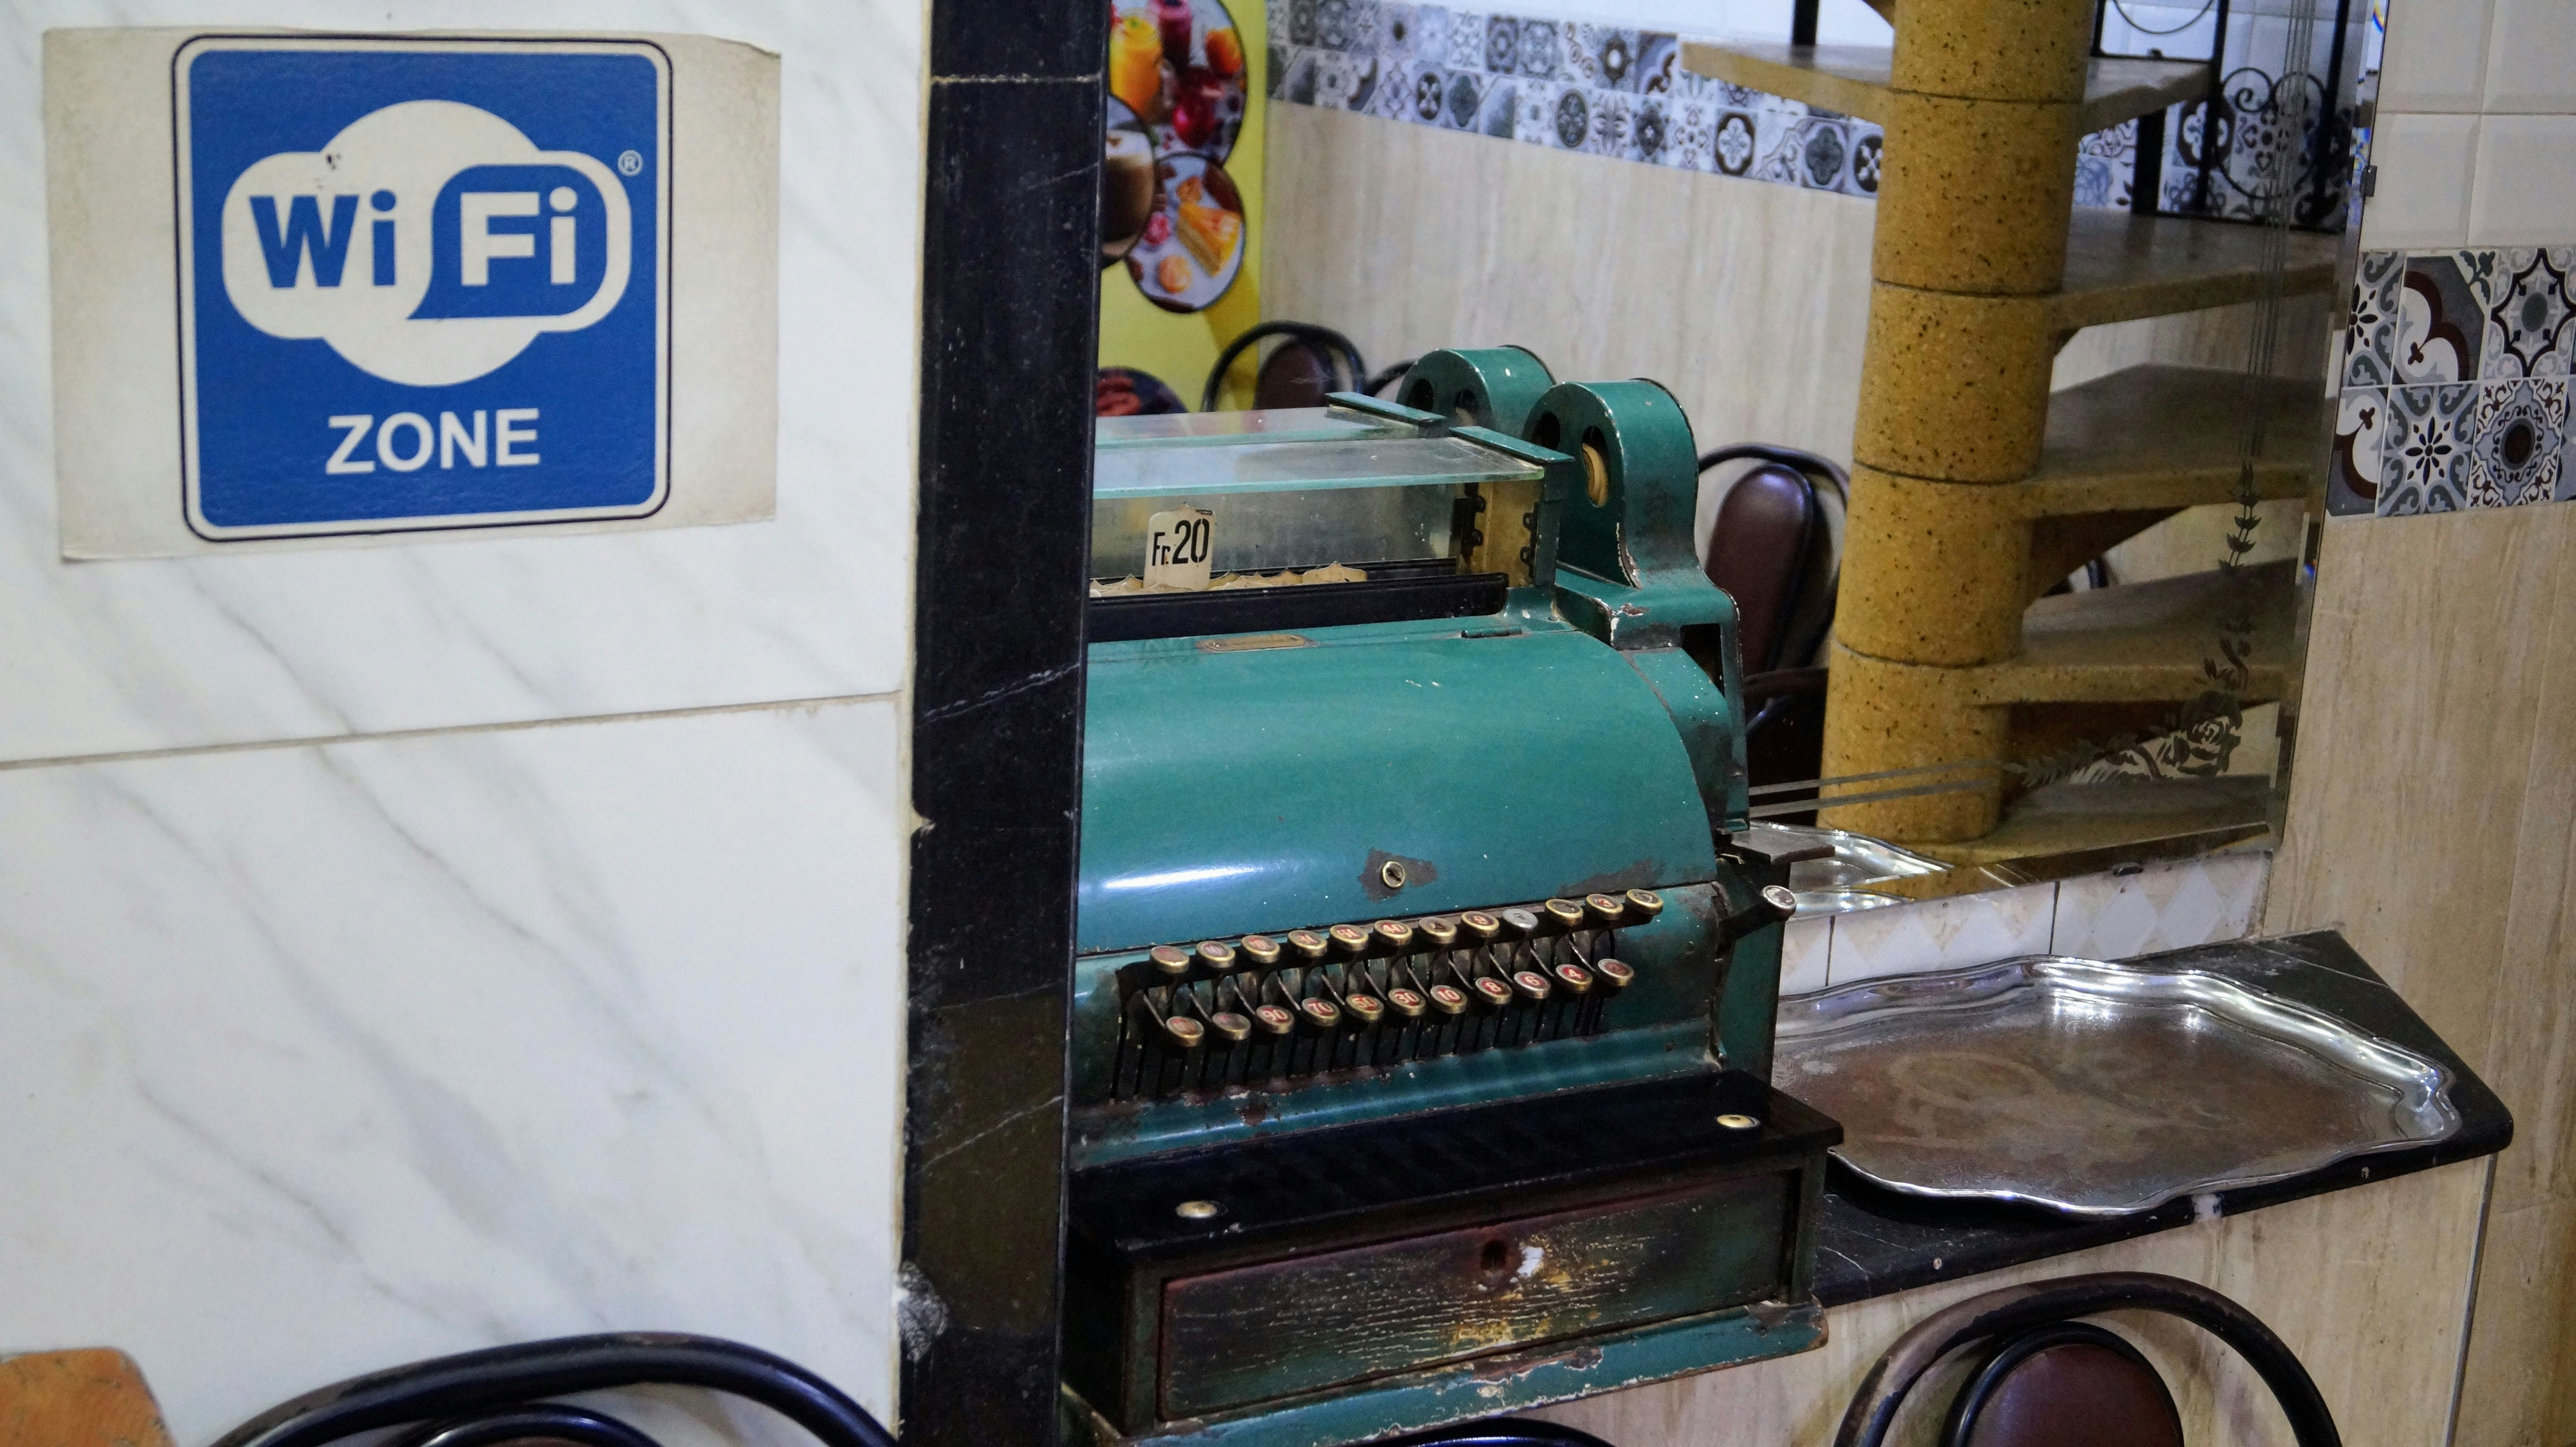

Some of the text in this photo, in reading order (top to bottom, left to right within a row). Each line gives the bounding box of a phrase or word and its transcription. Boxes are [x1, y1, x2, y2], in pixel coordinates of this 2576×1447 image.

[326, 408, 541, 475] ZONE
[1568, 968, 1583, 979] 4
[1485, 981, 1502, 992] 8
[1524, 976, 1540, 986] 6
[1394, 992, 1419, 1004] 30
[1437, 989, 1461, 1001] 10
[1307, 1002, 1334, 1014] 70
[1261, 1008, 1288, 1021] 90
